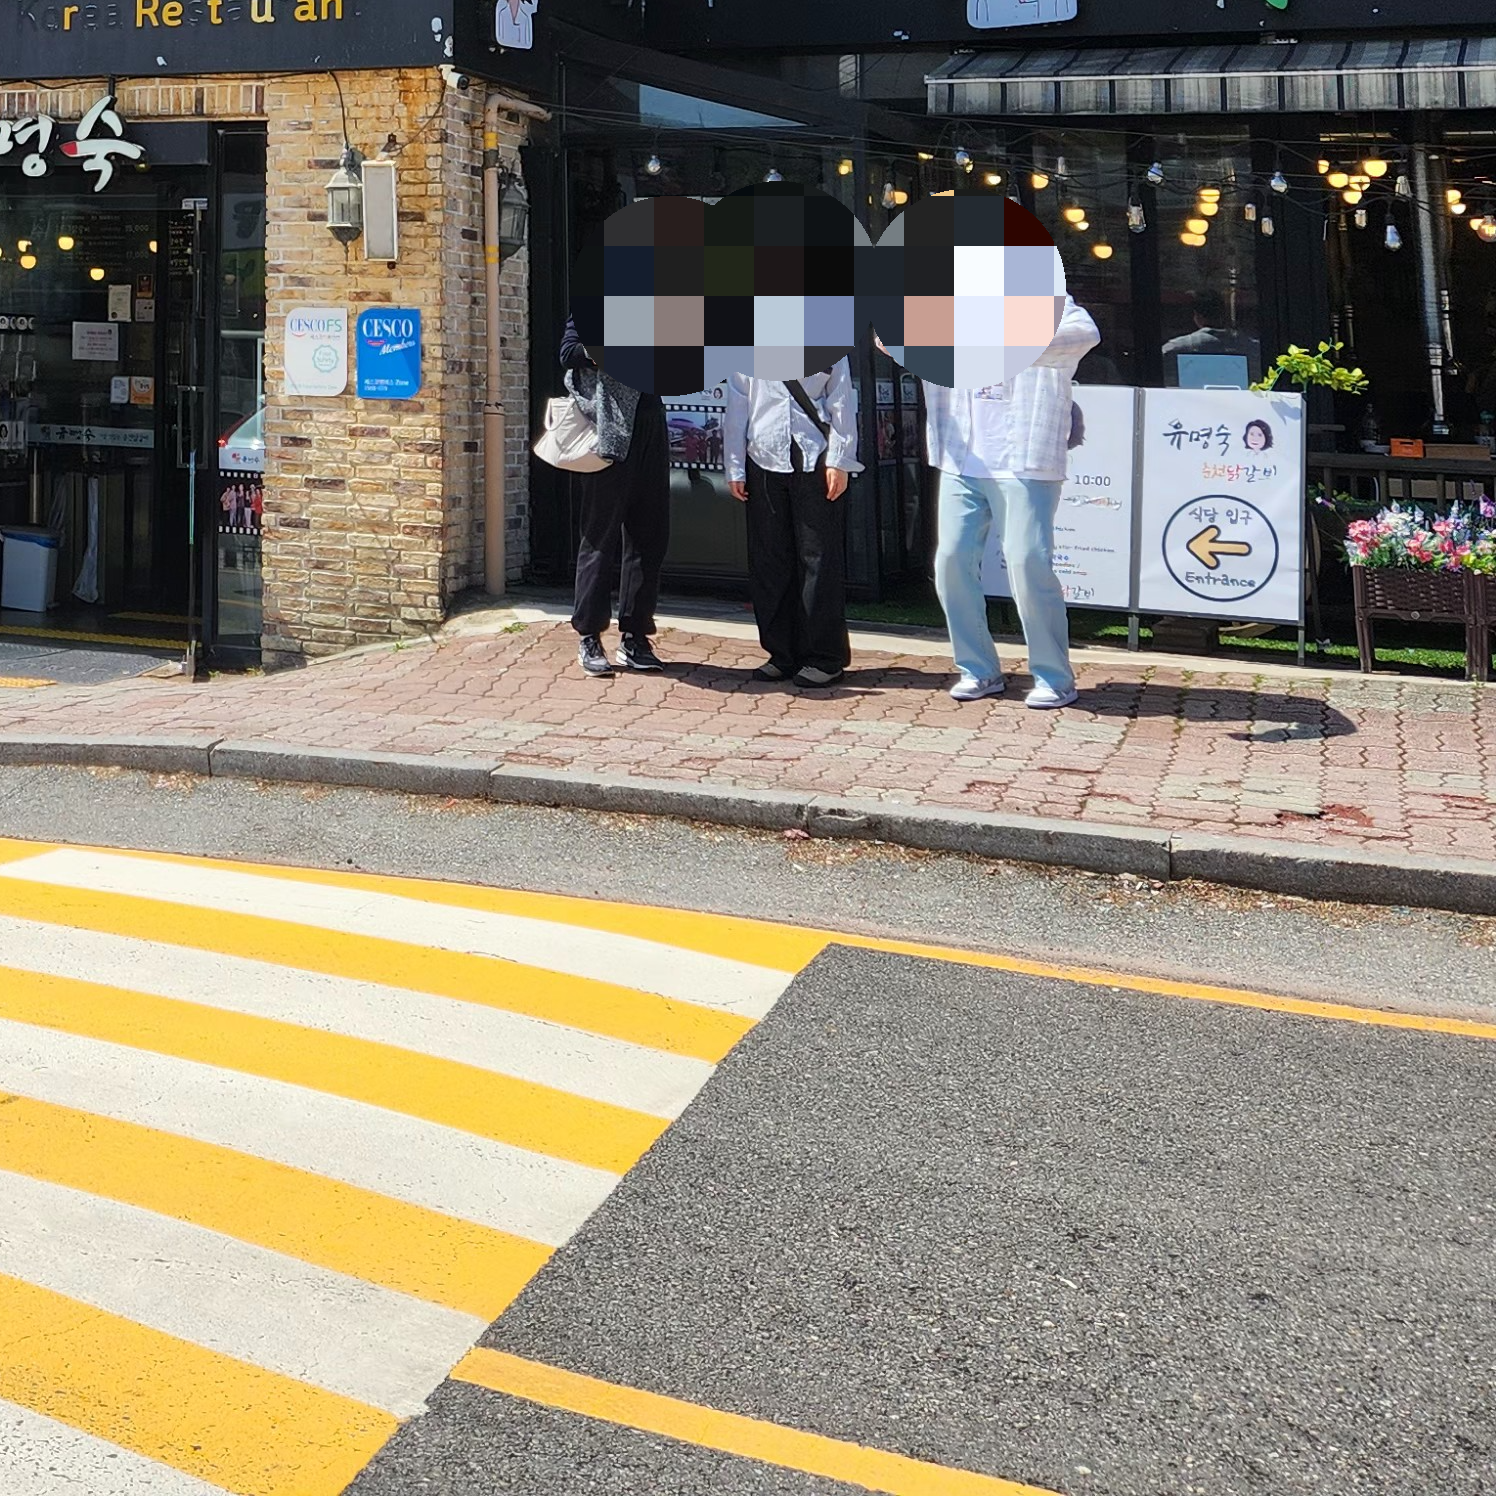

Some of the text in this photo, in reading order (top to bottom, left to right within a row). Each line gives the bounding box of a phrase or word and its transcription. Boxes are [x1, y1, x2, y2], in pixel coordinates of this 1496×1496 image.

[362, 318, 414, 338] CESCO
[1162, 418, 1232, 456] 유명숙
[1074, 474, 1112, 487] 10:00
[1202, 462, 1277, 483] 춘천닭갈비
[1188, 506, 1253, 526] 식당 입구
[1184, 570, 1256, 588] Entrance
